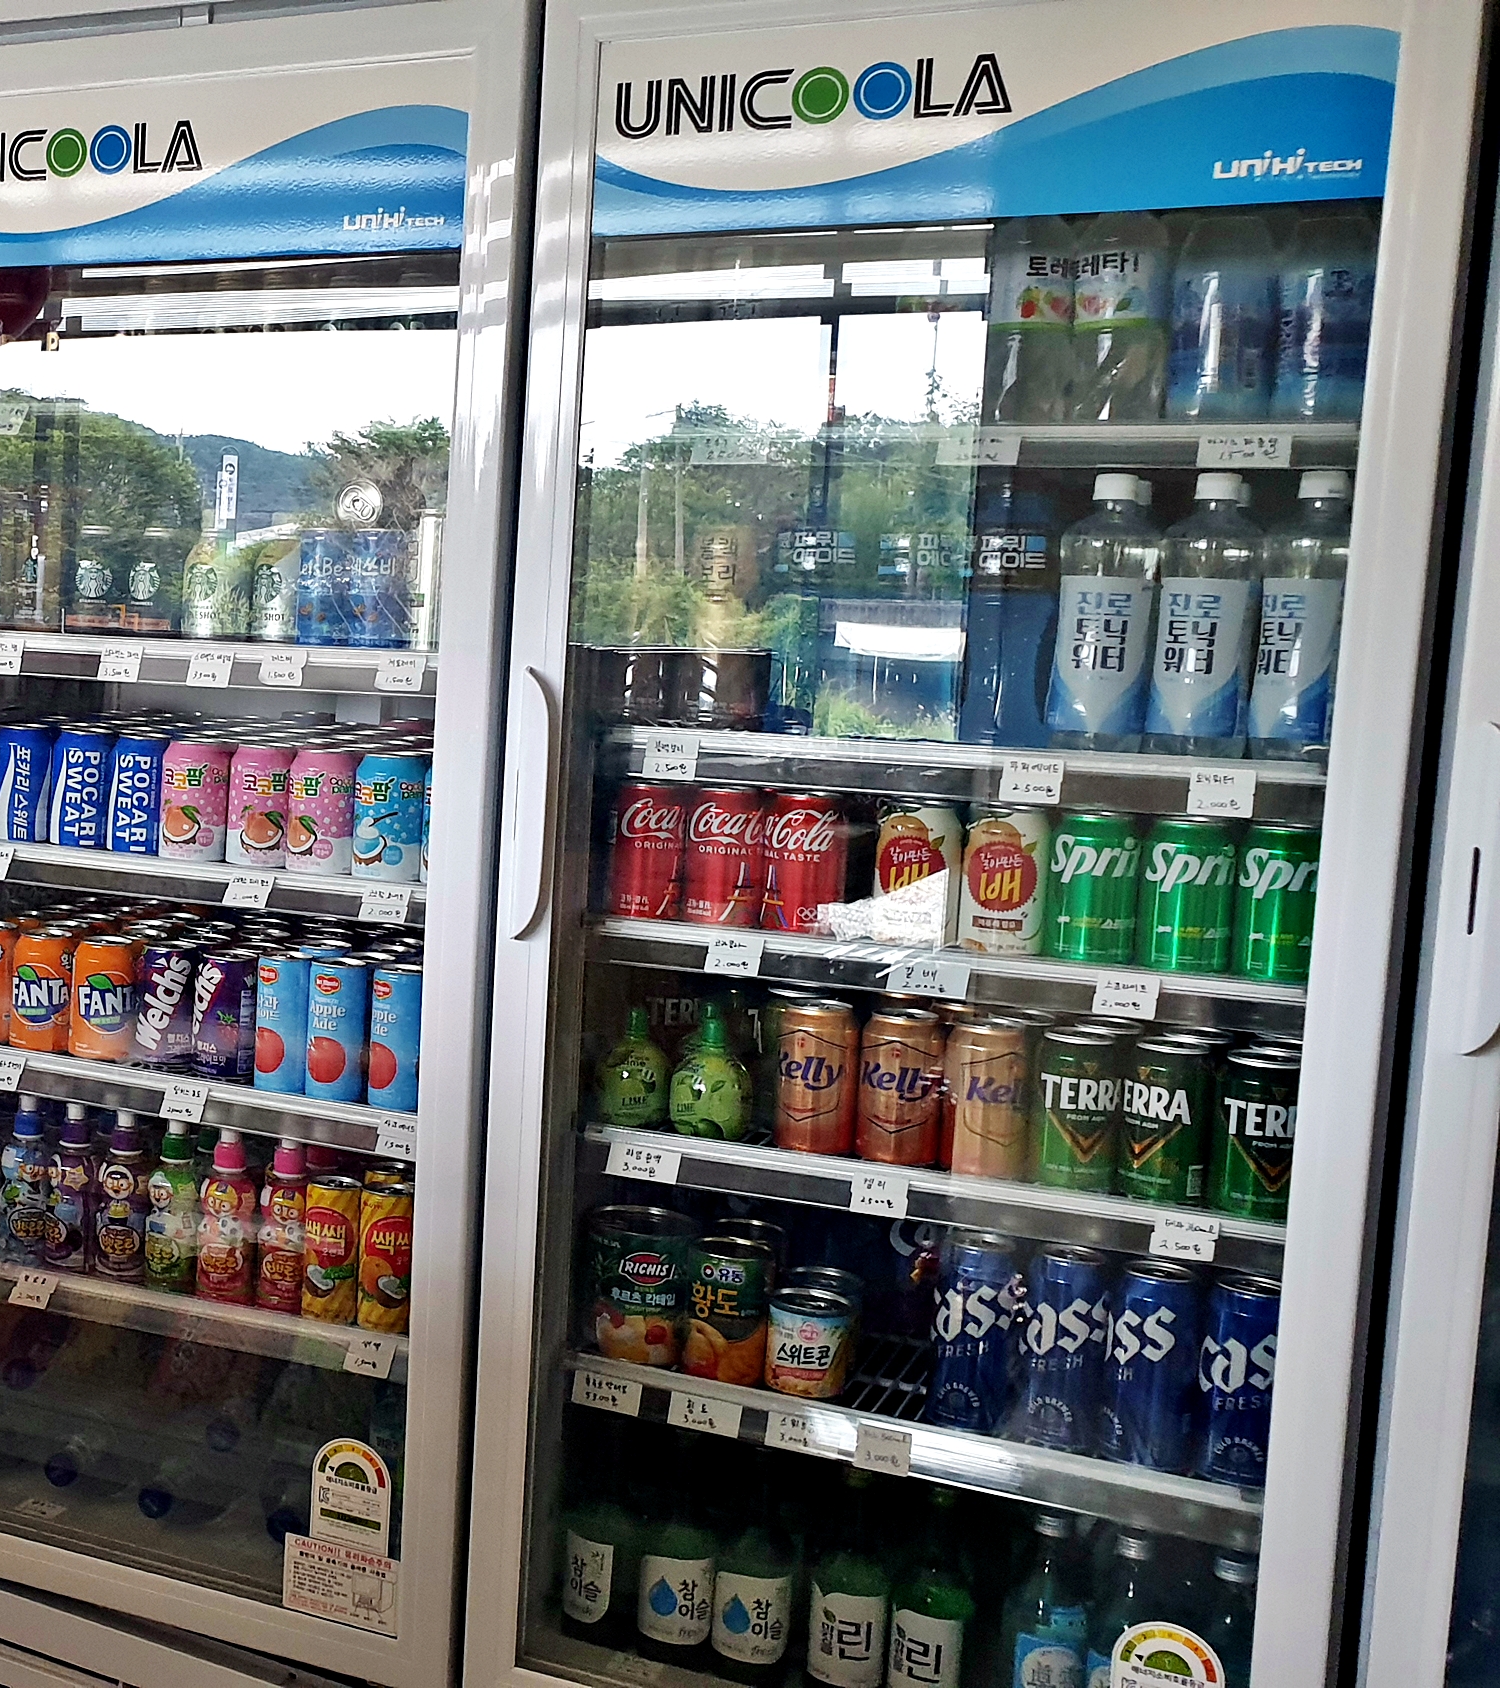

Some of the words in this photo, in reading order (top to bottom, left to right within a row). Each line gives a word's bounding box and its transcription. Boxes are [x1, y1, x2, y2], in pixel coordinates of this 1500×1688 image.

[614, 52, 1013, 139] UNICOOLA
[1305, 158, 1363, 176] TECH
[407, 215, 445, 226] TECH
[1026, 255, 1069, 278] 토레
[1073, 252, 1140, 279] 레타!
[1076, 591, 1132, 616] 진로
[1168, 593, 1221, 619] 진로
[1073, 618, 1128, 645] 토닉
[1166, 620, 1217, 647] 토닉
[1071, 646, 1125, 673] 워터
[1164, 648, 1213, 675] 워터
[164, 764, 204, 791] 코코팜
[243, 769, 289, 796] 코코팜
[64, 747, 85, 838] SWEAT
[79, 751, 101, 847] POCARI
[115, 752, 136, 843] SWEAT
[130, 755, 151, 853] POCARI
[783, 852, 821, 863] TASTE
[1051, 834, 1141, 884] Spri
[1145, 842, 1236, 893] Spri
[12, 975, 70, 1007] FANTA
[310, 1003, 347, 1019] Apple
[312, 1018, 338, 1031] Ade
[372, 1010, 398, 1023] pple
[373, 1024, 388, 1037] de
[624, 1256, 671, 1277] RICHIS
[691, 1281, 740, 1318] 황도
[776, 1344, 832, 1367] 스위트콘
[1213, 1395, 1264, 1411] FRES
[571, 1554, 588, 1578] 참
[570, 1576, 602, 1603] 이슬
[677, 1579, 699, 1602] 참
[678, 1598, 712, 1621] 이슬
[751, 1598, 773, 1621] 참
[751, 1619, 784, 1641] 이슬
[836, 1619, 873, 1662] 린
[905, 1637, 943, 1684] 린
